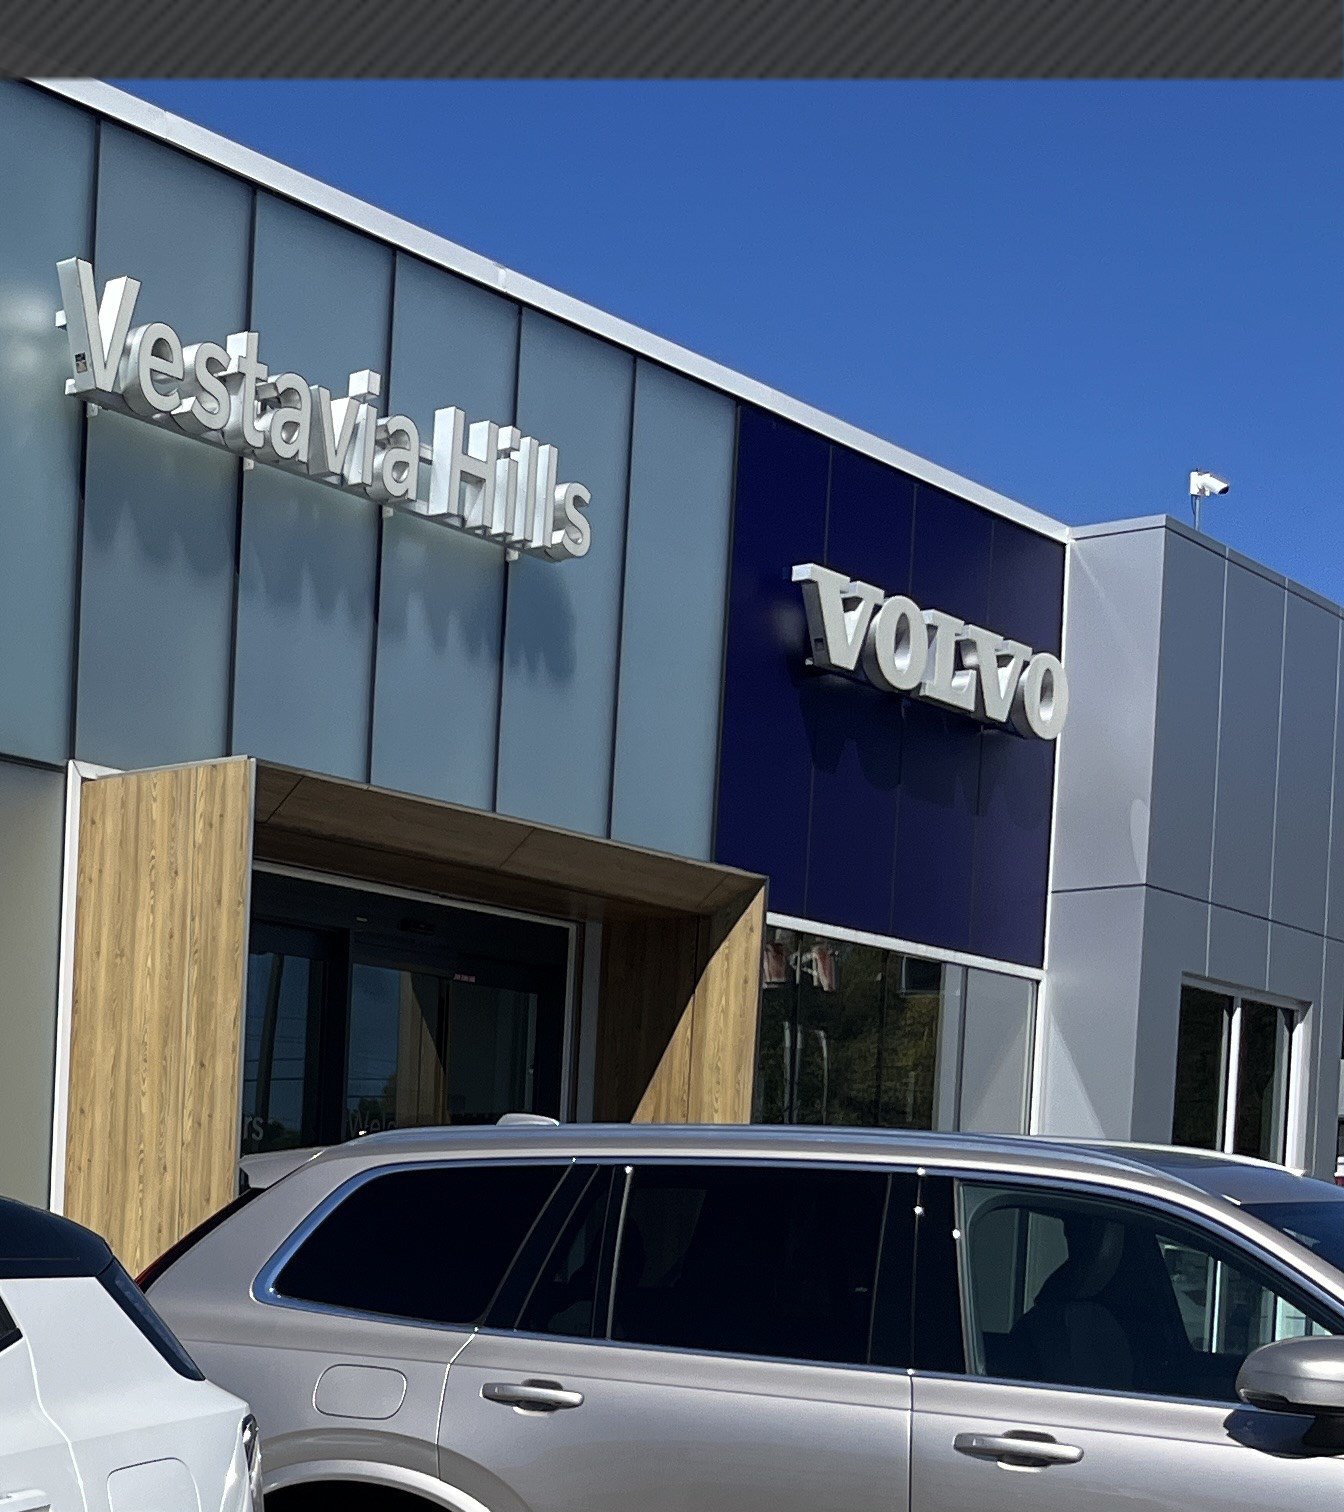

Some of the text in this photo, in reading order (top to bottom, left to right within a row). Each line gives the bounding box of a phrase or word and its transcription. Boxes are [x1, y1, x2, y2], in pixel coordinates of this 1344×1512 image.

[55, 257, 592, 562] Vestavia Hills
[791, 562, 1069, 741] VOLVO
